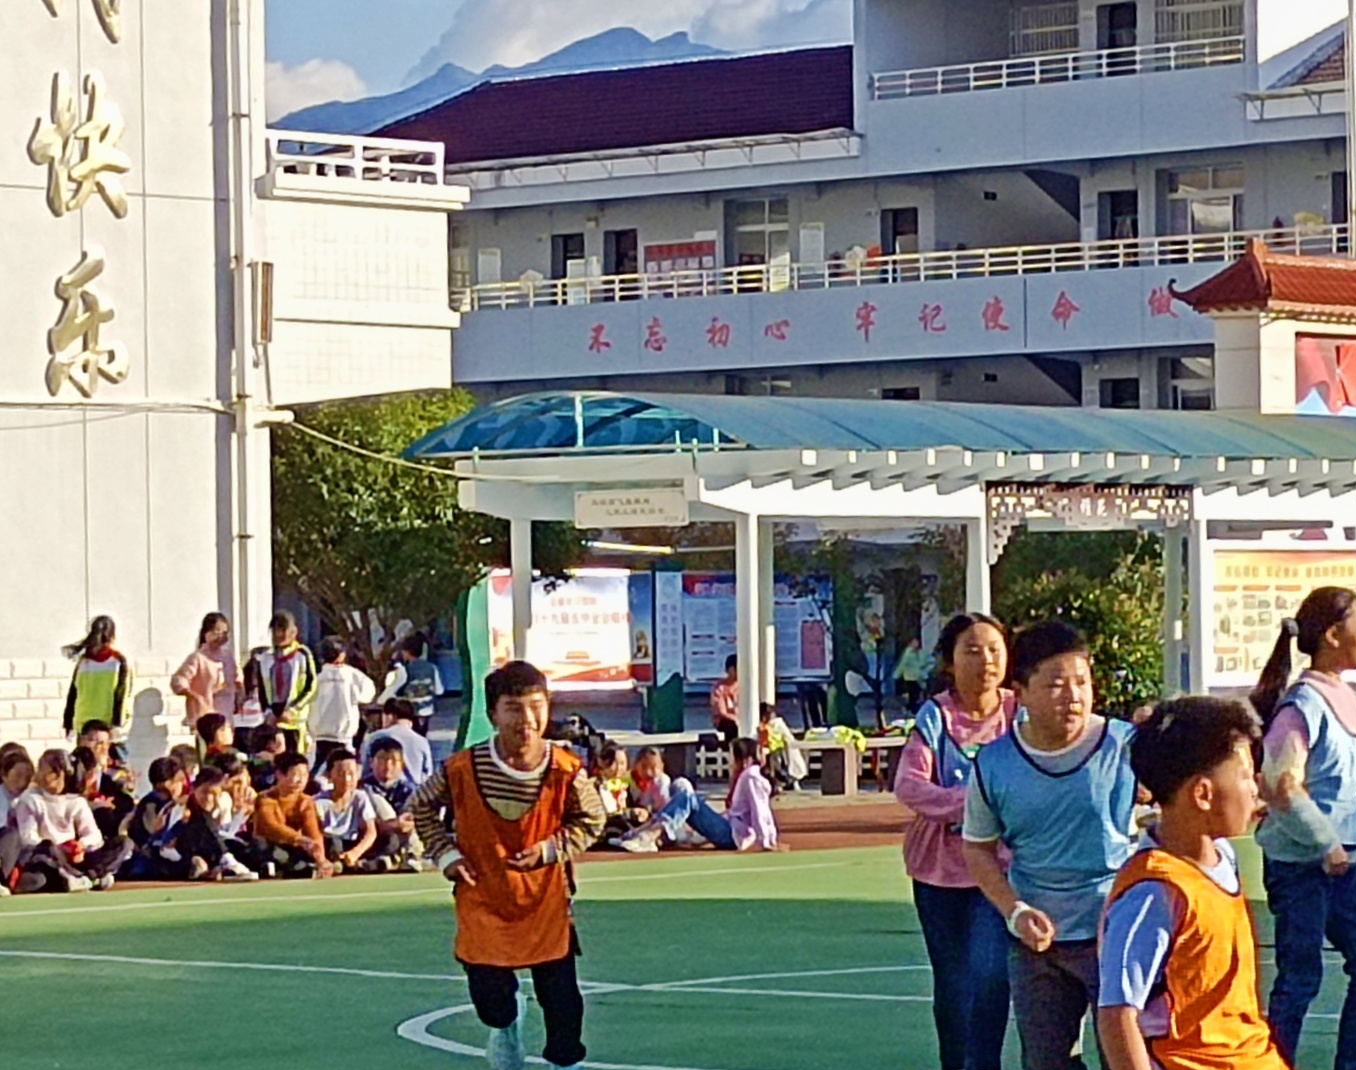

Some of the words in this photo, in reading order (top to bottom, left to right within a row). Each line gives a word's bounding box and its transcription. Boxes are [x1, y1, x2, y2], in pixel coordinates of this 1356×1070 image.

[26, 0, 131, 398] 快乐
[588, 316, 791, 353] 不忘初心
[856, 290, 1081, 342] 牢记使命
